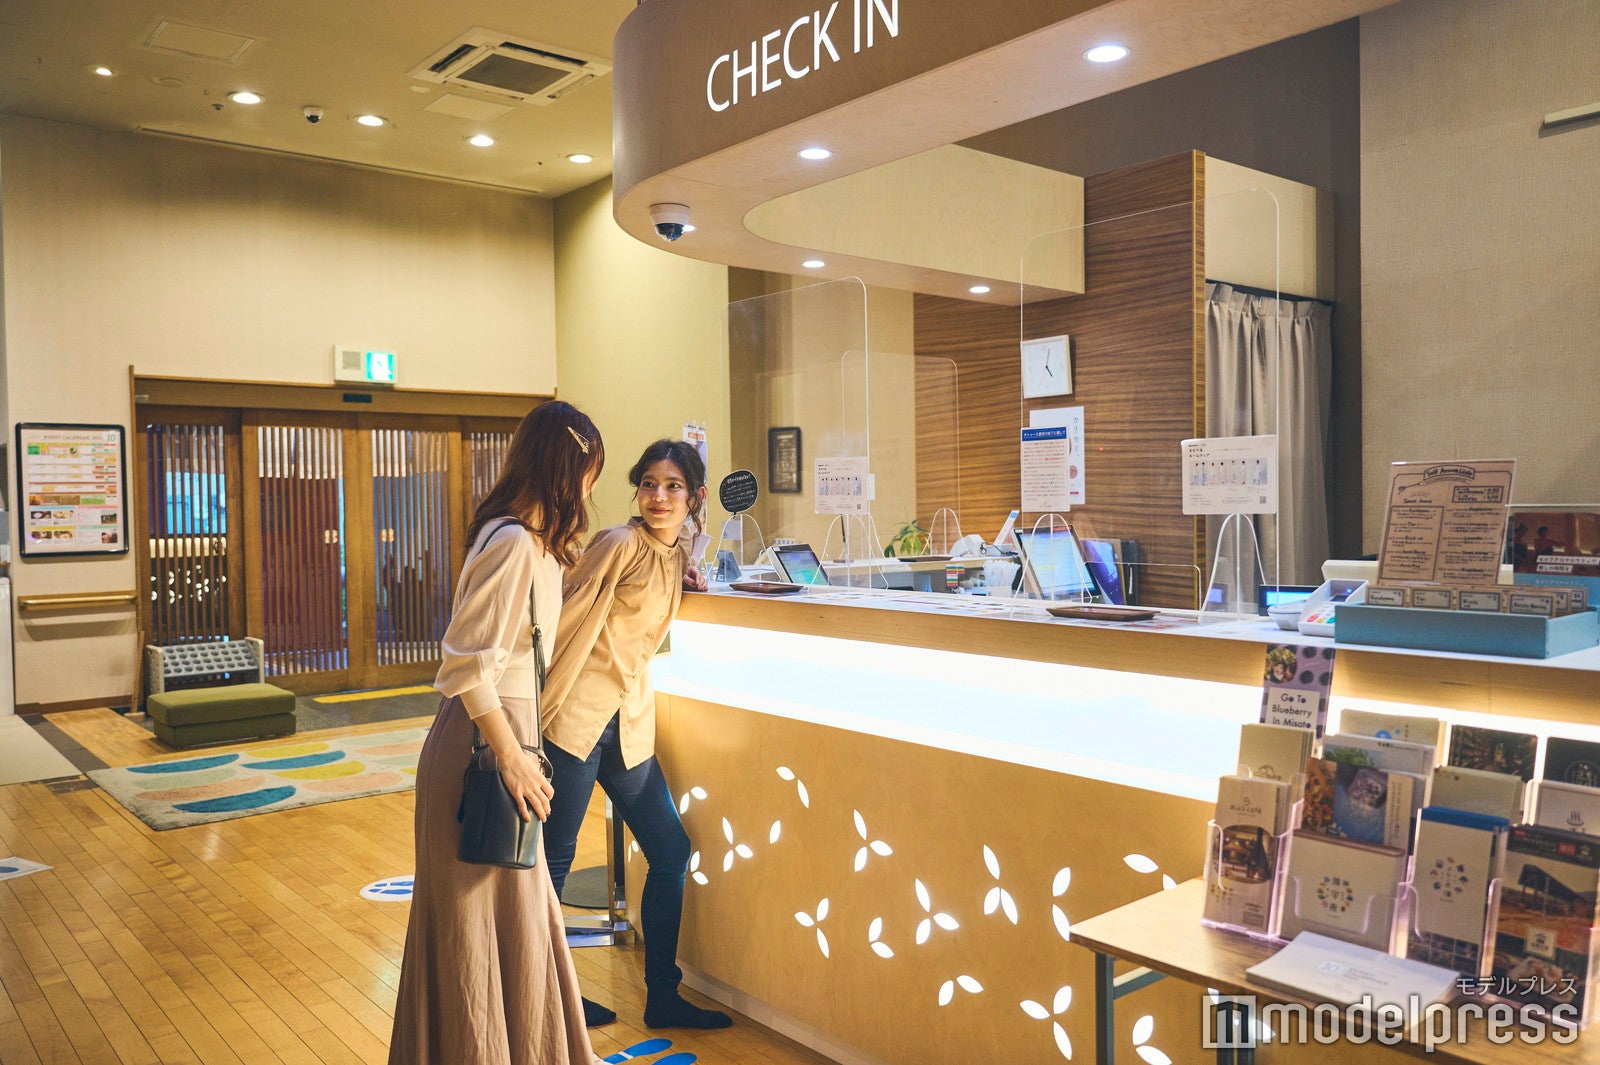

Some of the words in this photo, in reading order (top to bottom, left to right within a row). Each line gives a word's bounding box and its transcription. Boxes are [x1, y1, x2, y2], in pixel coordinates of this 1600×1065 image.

[706, 1, 841, 112] CHECK
[853, 0, 899, 54] IN
[1281, 693, 1294, 702] Go
[1297, 694, 1306, 703] To
[1271, 704, 1312, 718] Blueberry
[1282, 718, 1311, 729] Misato
